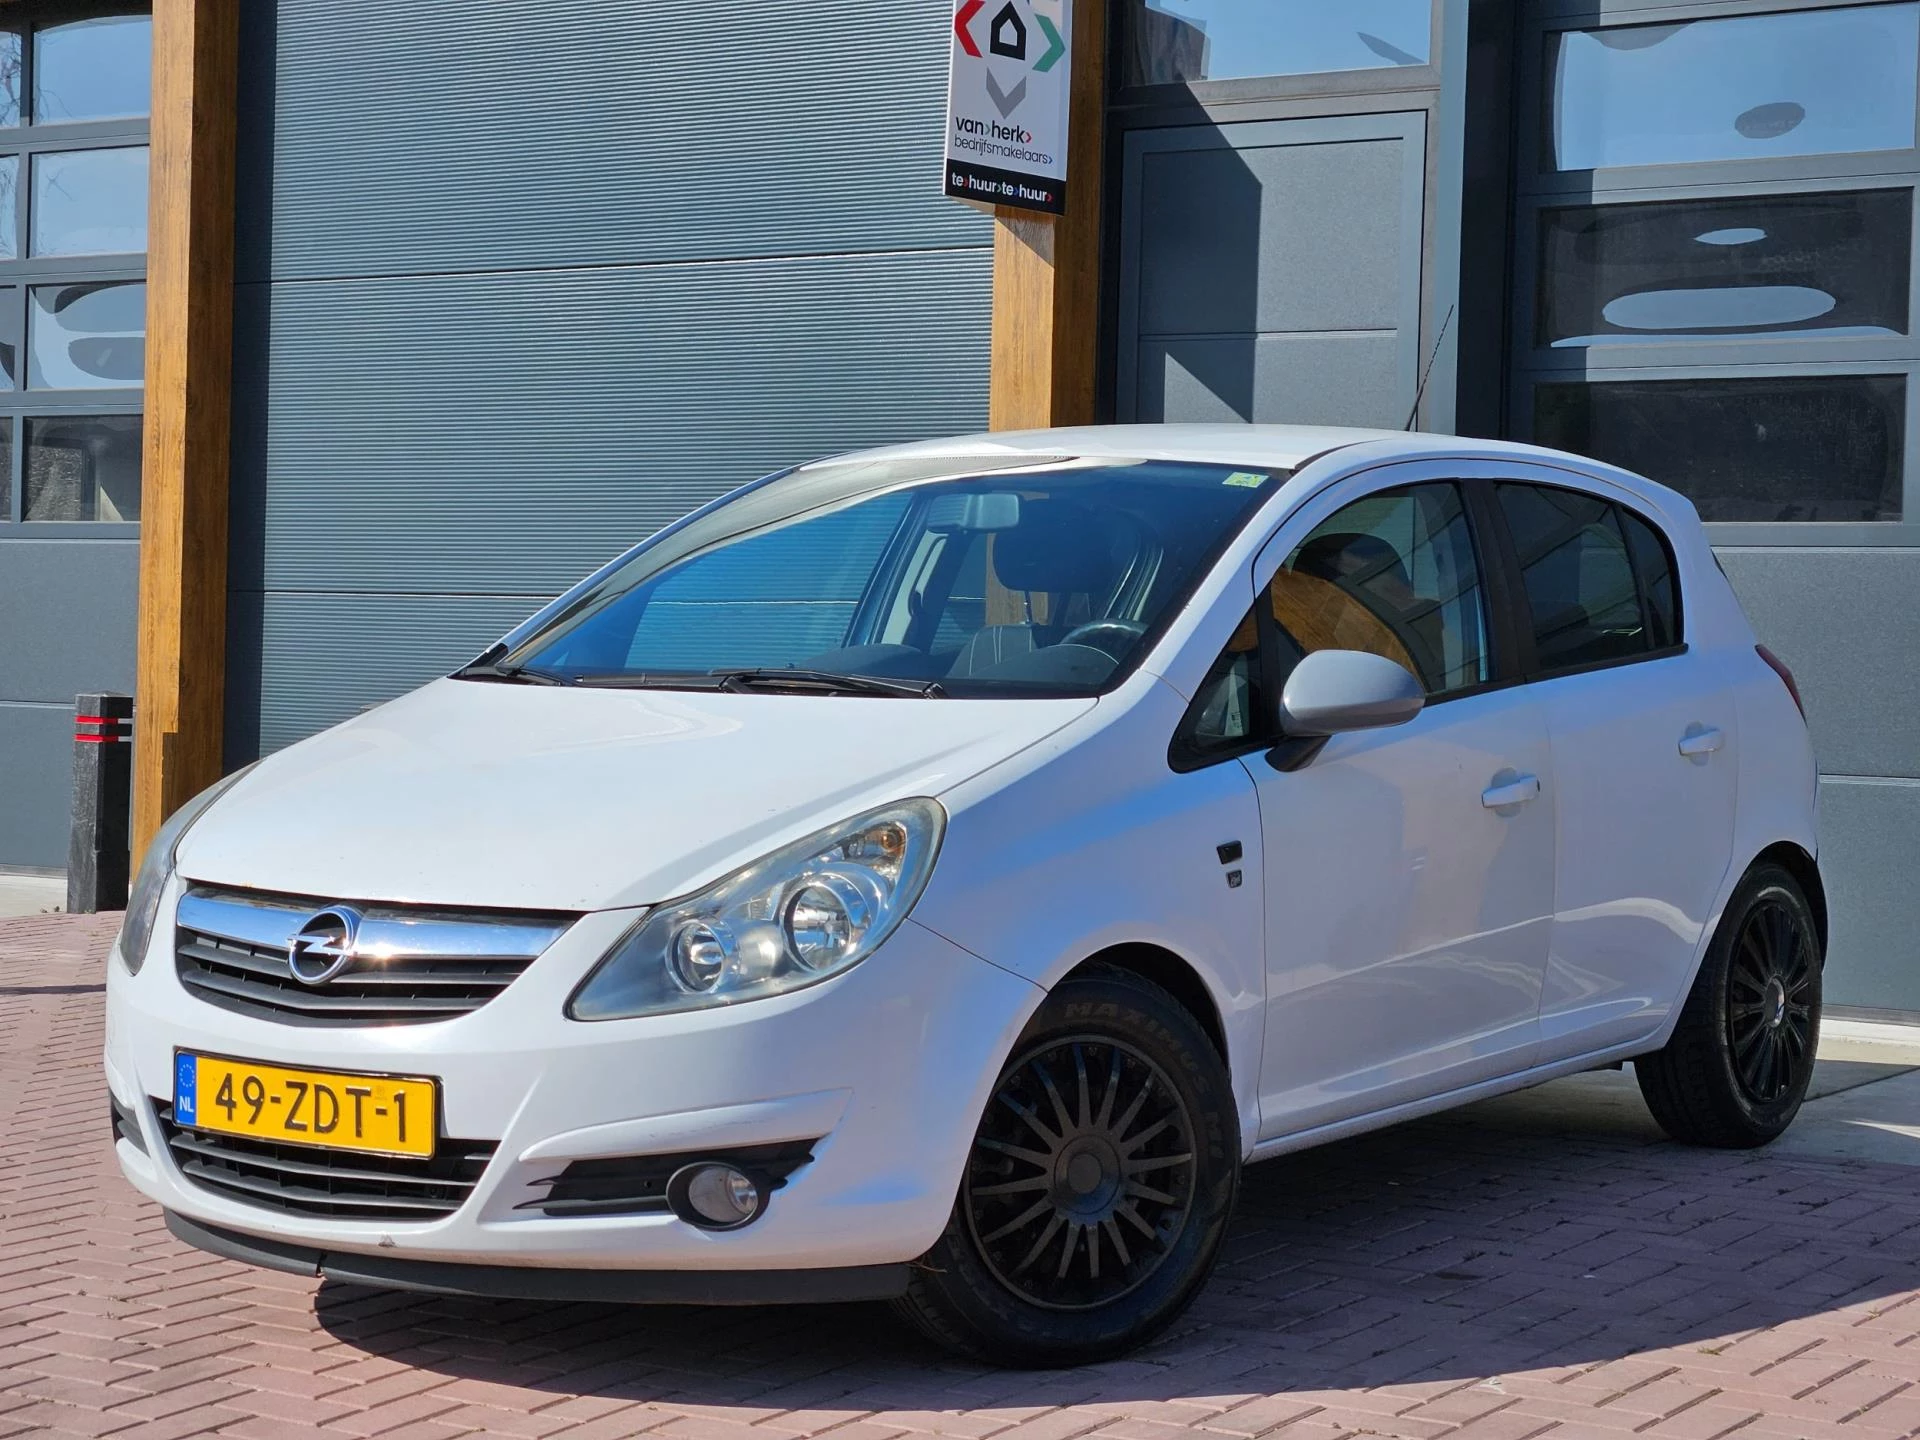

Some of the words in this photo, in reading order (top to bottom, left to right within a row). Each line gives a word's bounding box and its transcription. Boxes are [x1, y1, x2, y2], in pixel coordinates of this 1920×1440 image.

[954, 134, 1048, 164] bedrijfsmakelaars
[180, 1096, 194, 1112] NL
[215, 1073, 406, 1142] 49-ZDT-1
